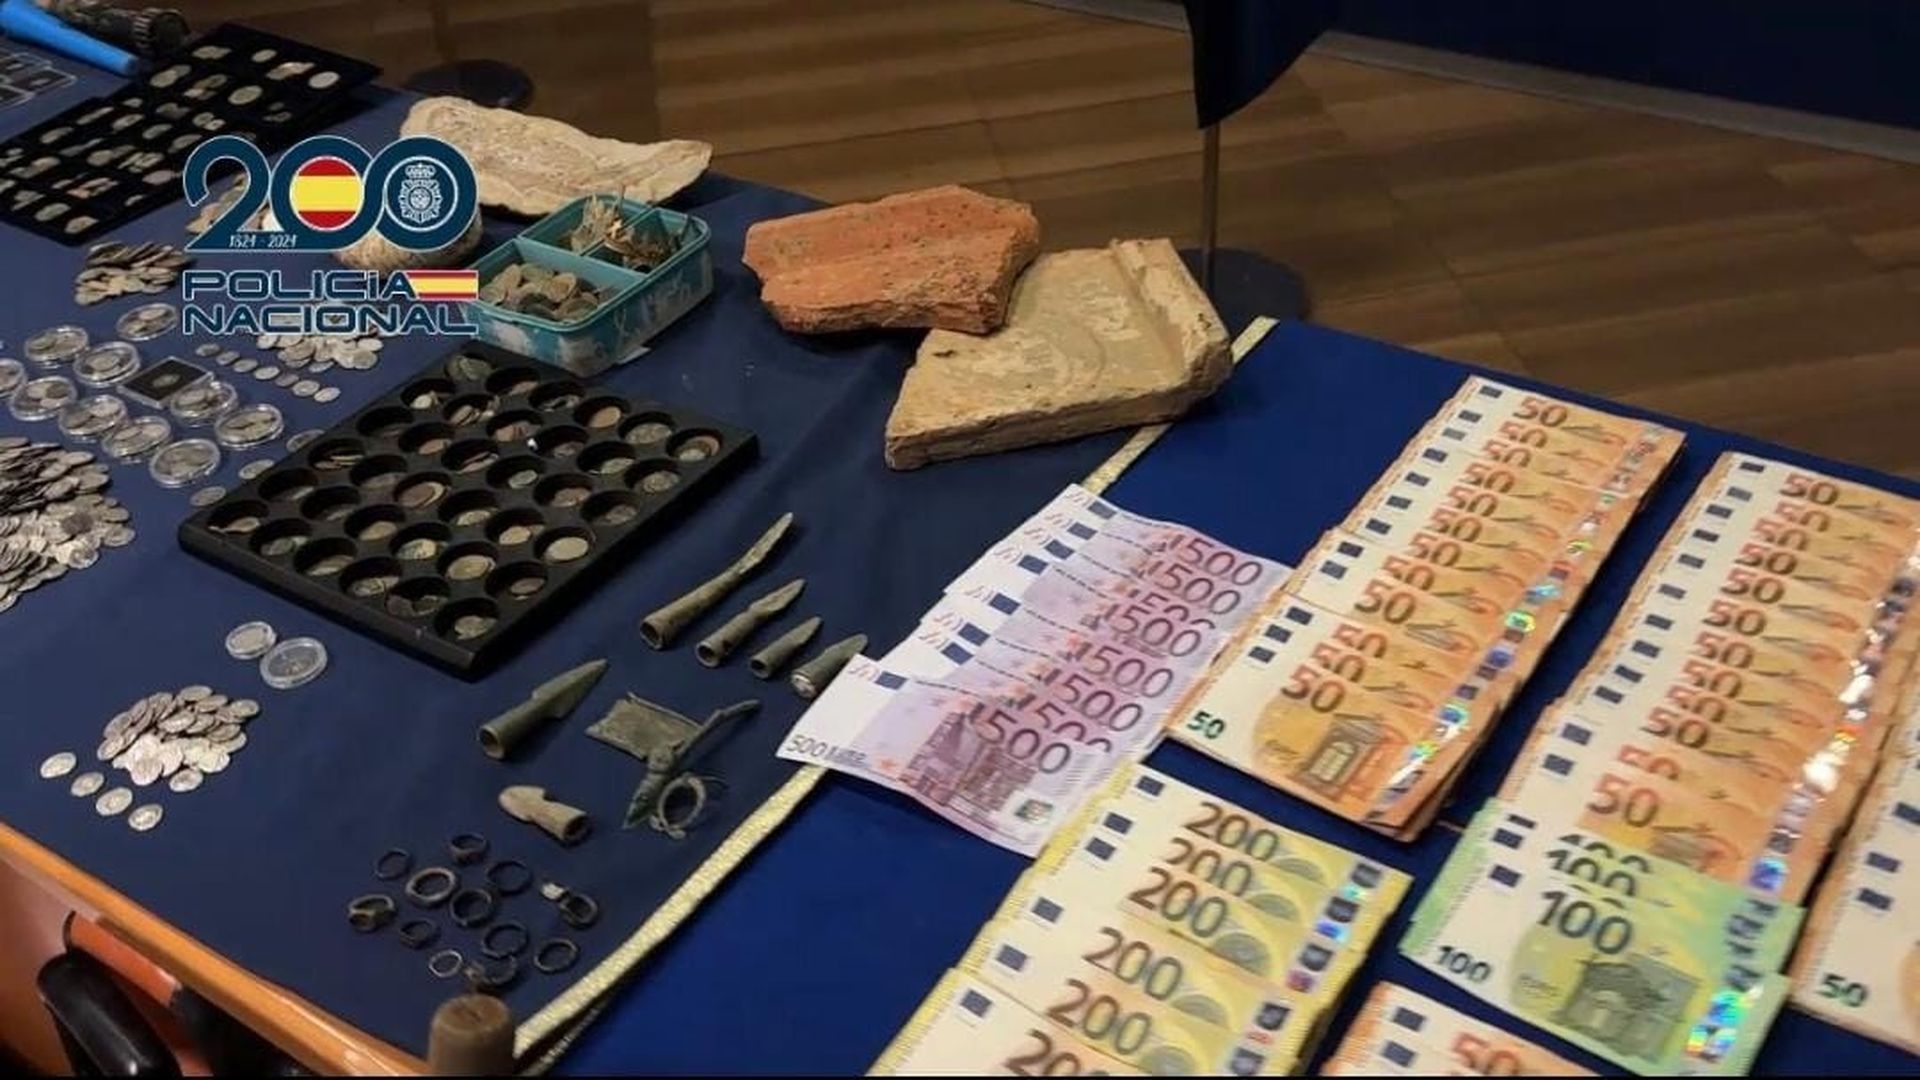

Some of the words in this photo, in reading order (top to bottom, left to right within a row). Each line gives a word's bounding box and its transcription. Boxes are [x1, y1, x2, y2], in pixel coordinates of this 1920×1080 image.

[1512, 397, 1568, 427] 50
[1499, 421, 1548, 448] 50
[1459, 462, 1515, 493] 50
[1779, 472, 1839, 505] 50
[1447, 485, 1499, 517] 50
[1425, 507, 1482, 542] 50
[1407, 532, 1462, 567] 50
[1734, 541, 1798, 575] 50
[1354, 579, 1416, 624] 50
[1720, 567, 1785, 604] 50
[1702, 599, 1767, 636] 50
[1693, 631, 1754, 669] 50
[1281, 664, 1345, 713] 50
[1186, 711, 1226, 740] 50
[1640, 706, 1711, 748] 50
[1588, 773, 1659, 828] 50
[1183, 801, 1279, 862] 200
[1165, 837, 1252, 896] 200
[1128, 866, 1228, 938] 200
[1536, 890, 1633, 955] 100
[1081, 926, 1183, 1001] 200
[1435, 945, 1492, 982] 100
[1817, 973, 1868, 1008] 50
[1046, 978, 1152, 1055] 200
[1003, 1028, 1110, 1077] 20
